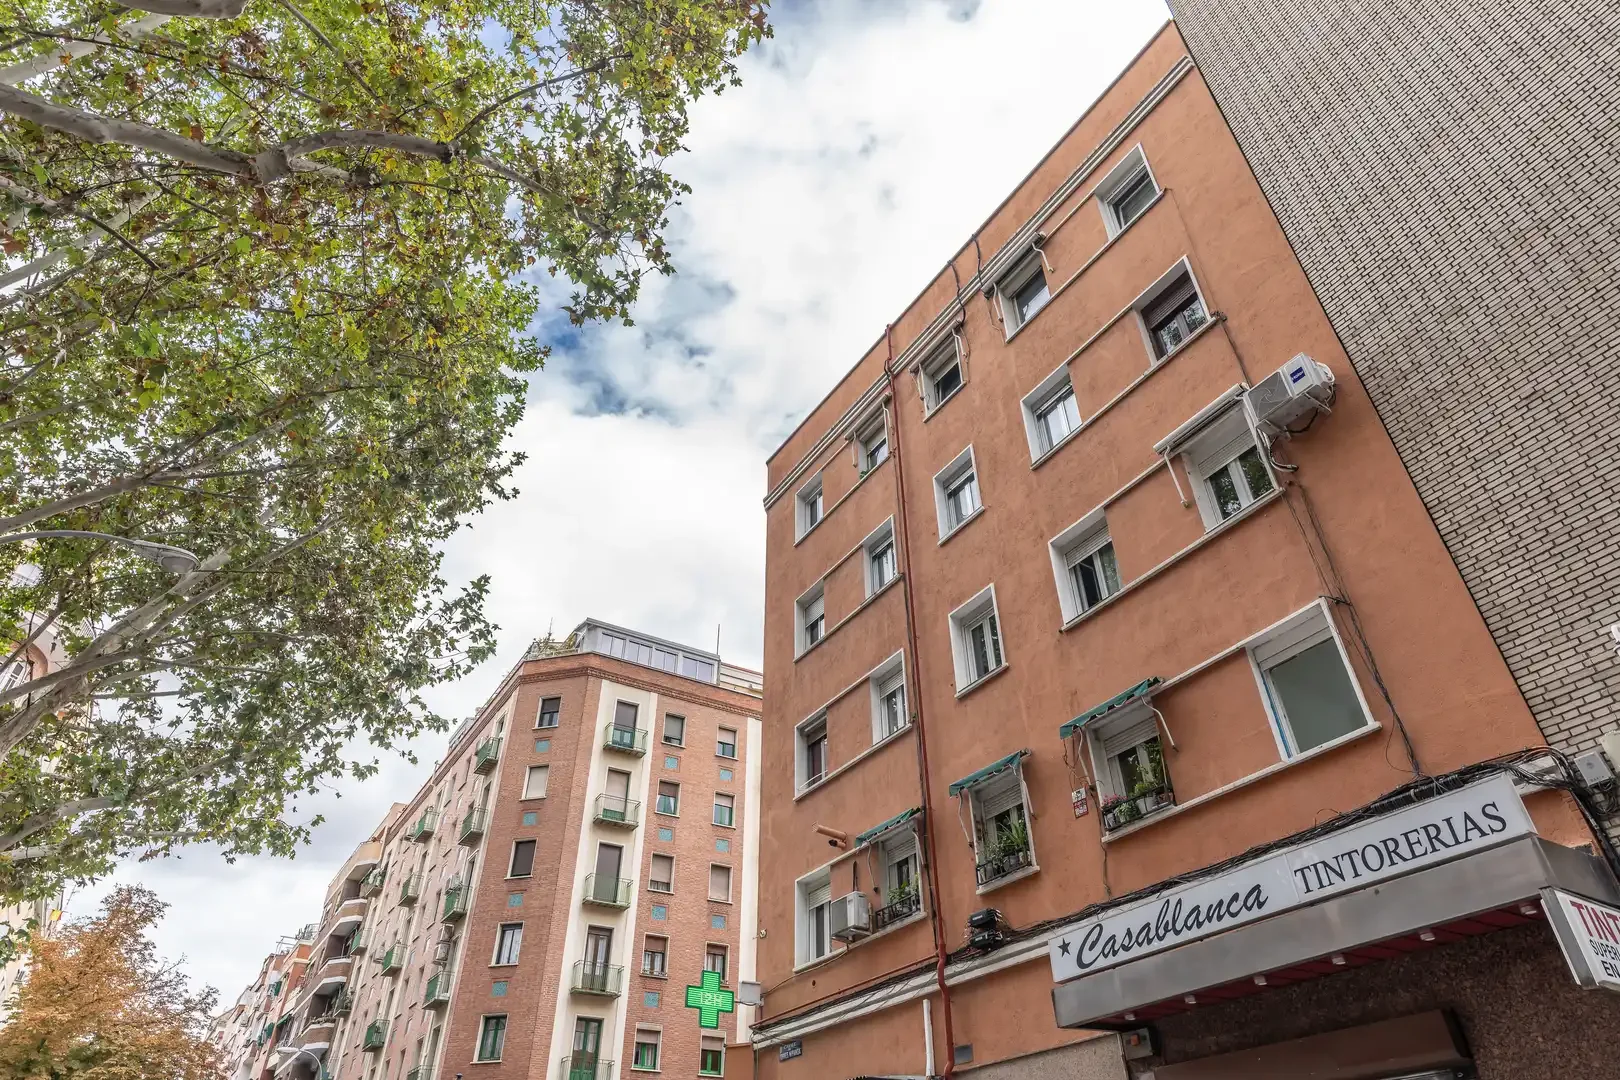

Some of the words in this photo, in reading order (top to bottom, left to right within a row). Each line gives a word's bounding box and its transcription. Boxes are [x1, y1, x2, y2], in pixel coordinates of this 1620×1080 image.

[1076, 884, 1269, 969] Casablanca
[1294, 801, 1507, 894] TINTORERIAS
[1569, 900, 1620, 945] TINT
